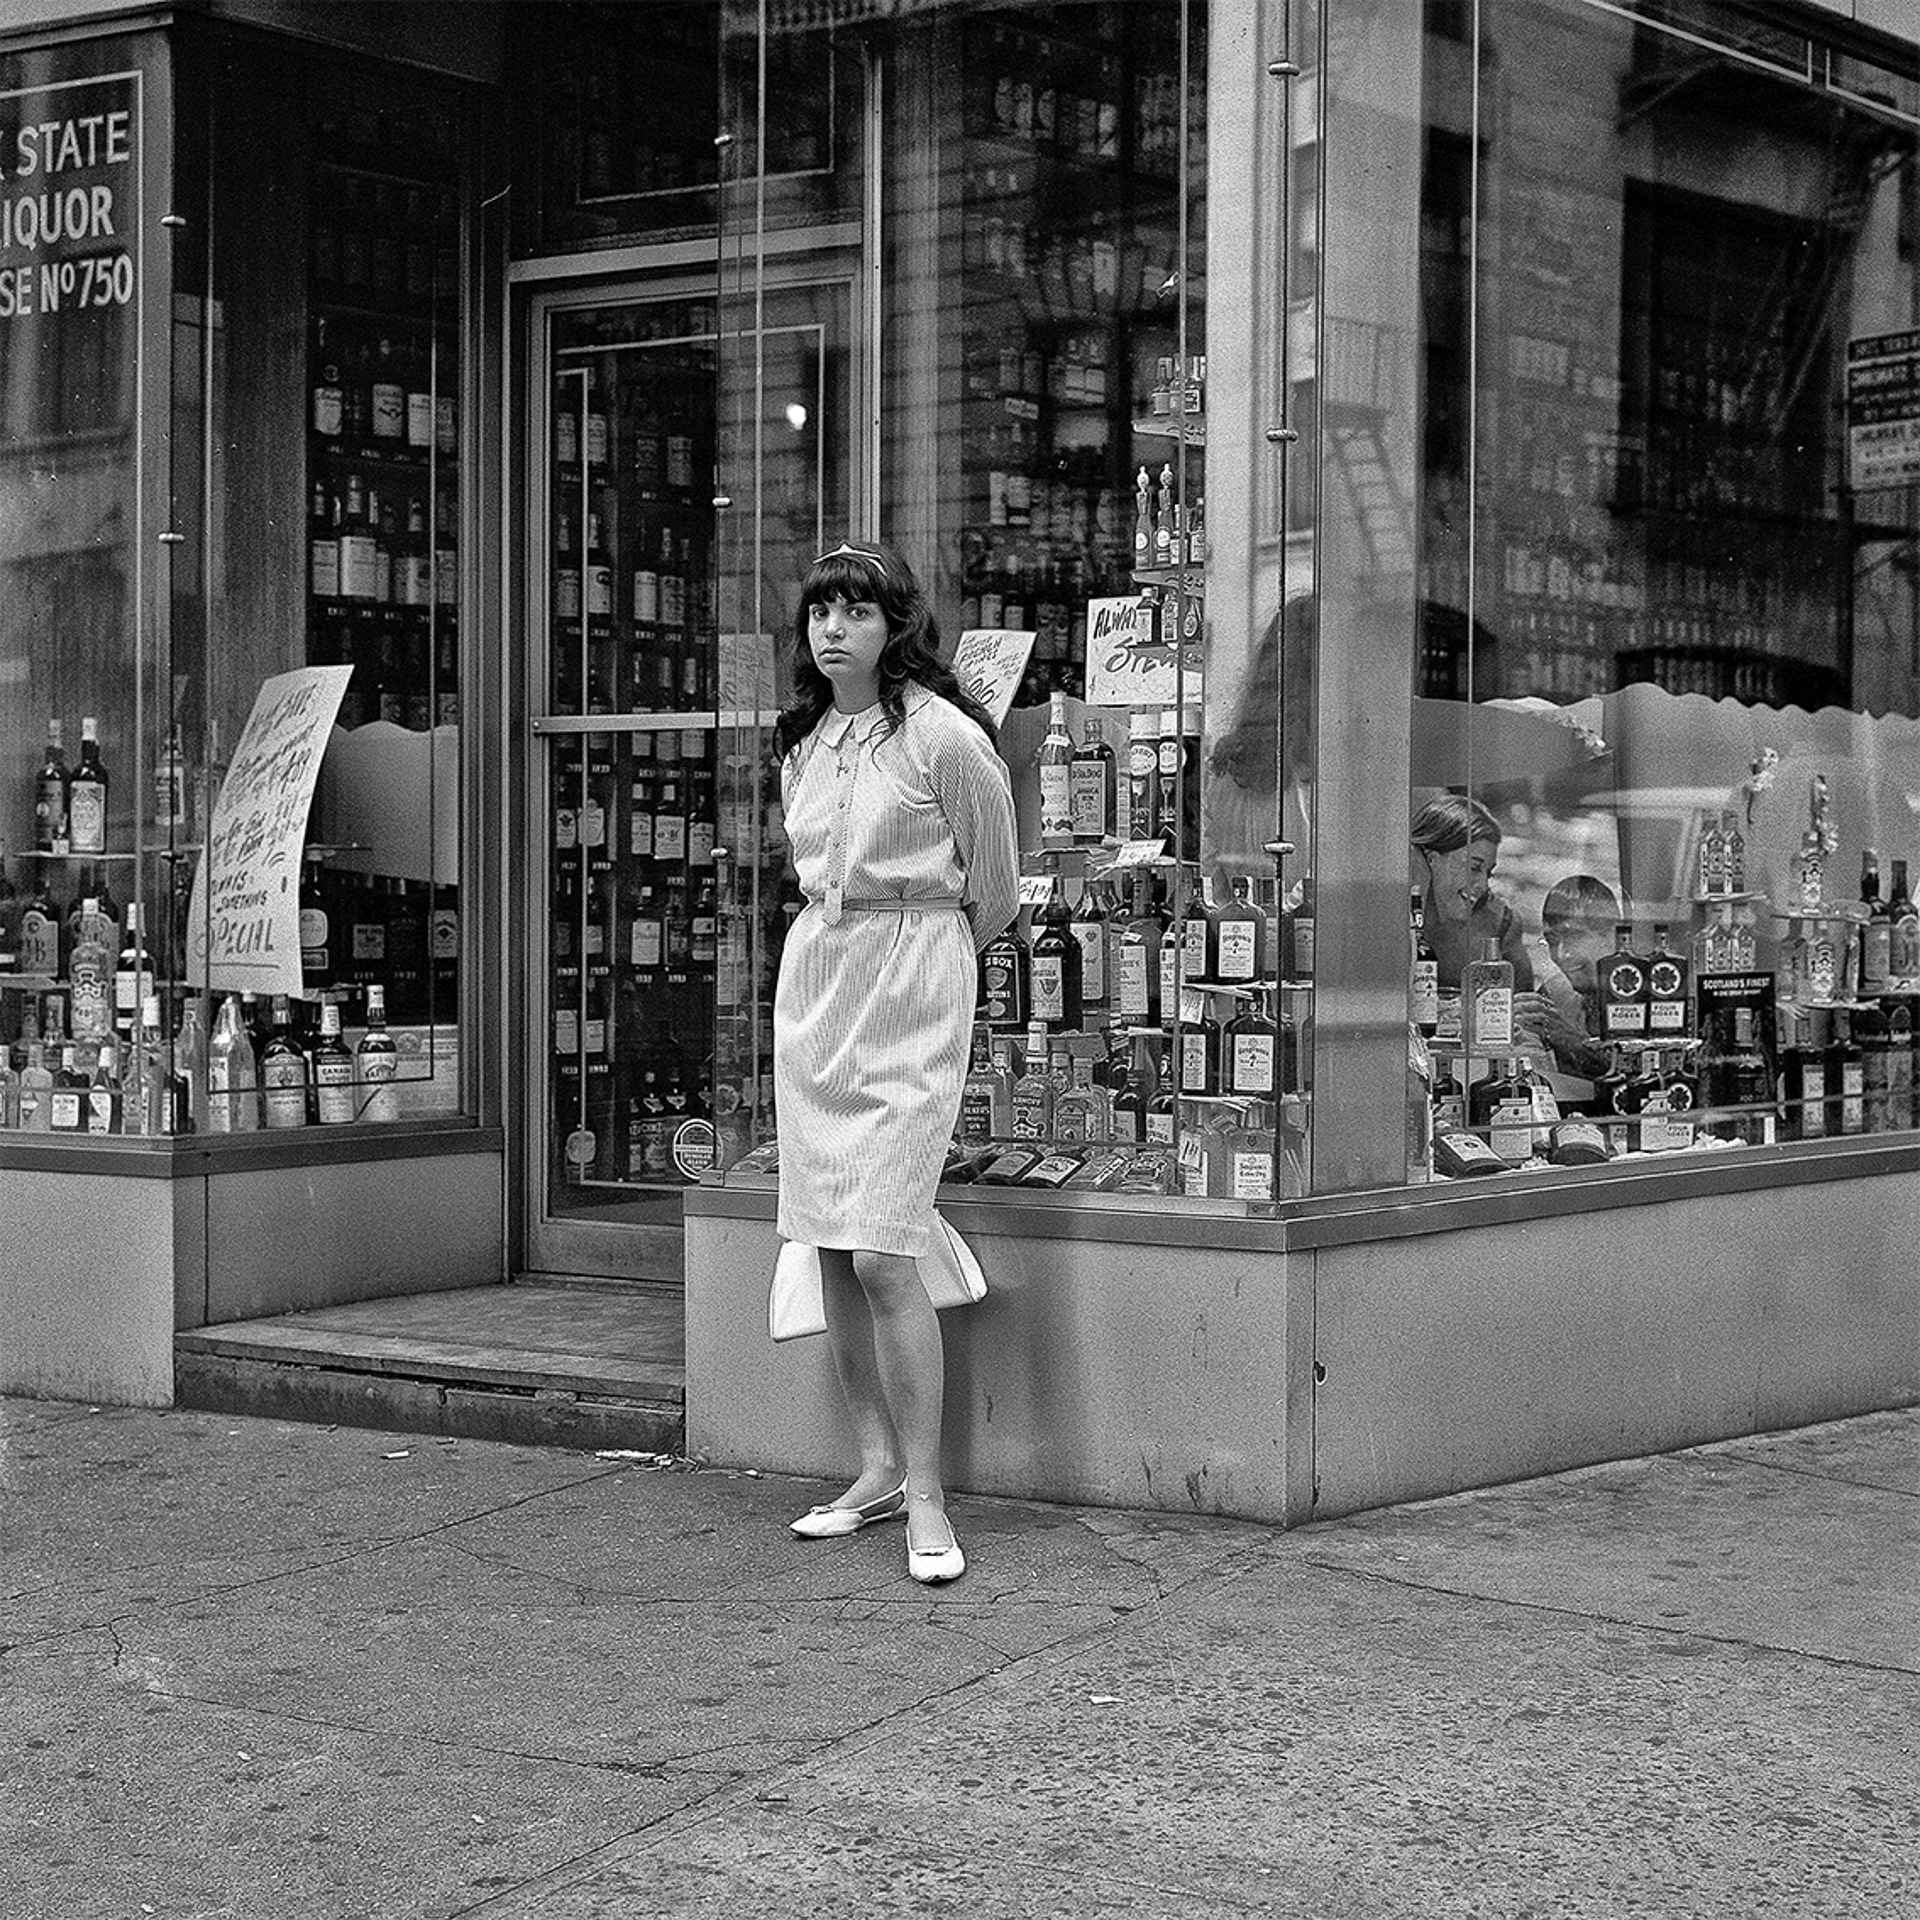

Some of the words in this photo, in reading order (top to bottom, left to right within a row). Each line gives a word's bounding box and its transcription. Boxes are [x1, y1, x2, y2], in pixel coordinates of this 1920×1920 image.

[17, 111, 130, 176] STATE
[992, 956, 1013, 969] BOX
[1703, 978, 1745, 990] SCOTLAND'S
[1746, 976, 1770, 988] FINEST
